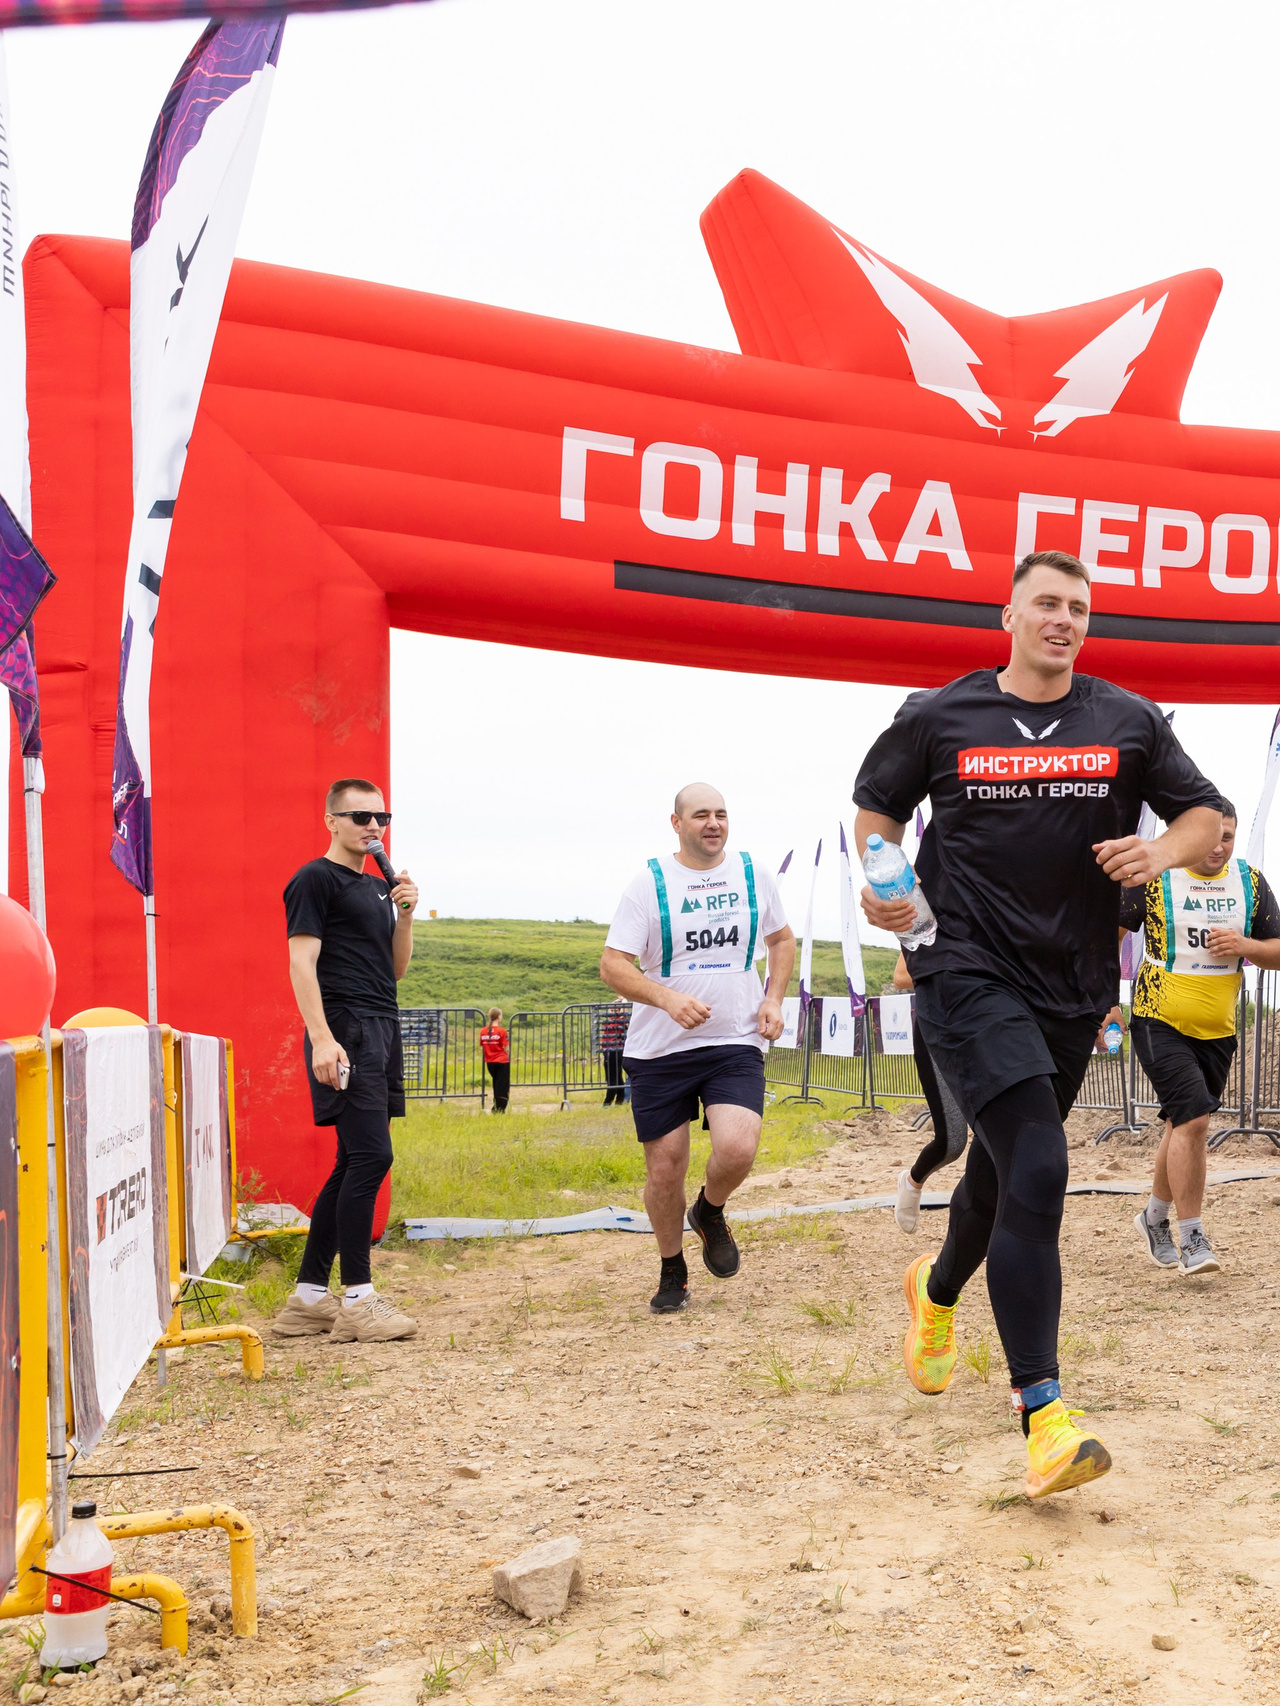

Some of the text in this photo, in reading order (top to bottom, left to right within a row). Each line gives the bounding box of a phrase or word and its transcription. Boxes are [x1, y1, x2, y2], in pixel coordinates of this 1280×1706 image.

[560, 426, 974, 571] ГОНКА
[964, 753, 1111, 775] ИНСТРУКТОР
[966, 782, 1109, 800] ГОНКА ГЕРОЕВ
[706, 892, 739, 911] RFP
[1206, 898, 1236, 912] RFP
[686, 925, 739, 951] 5044
